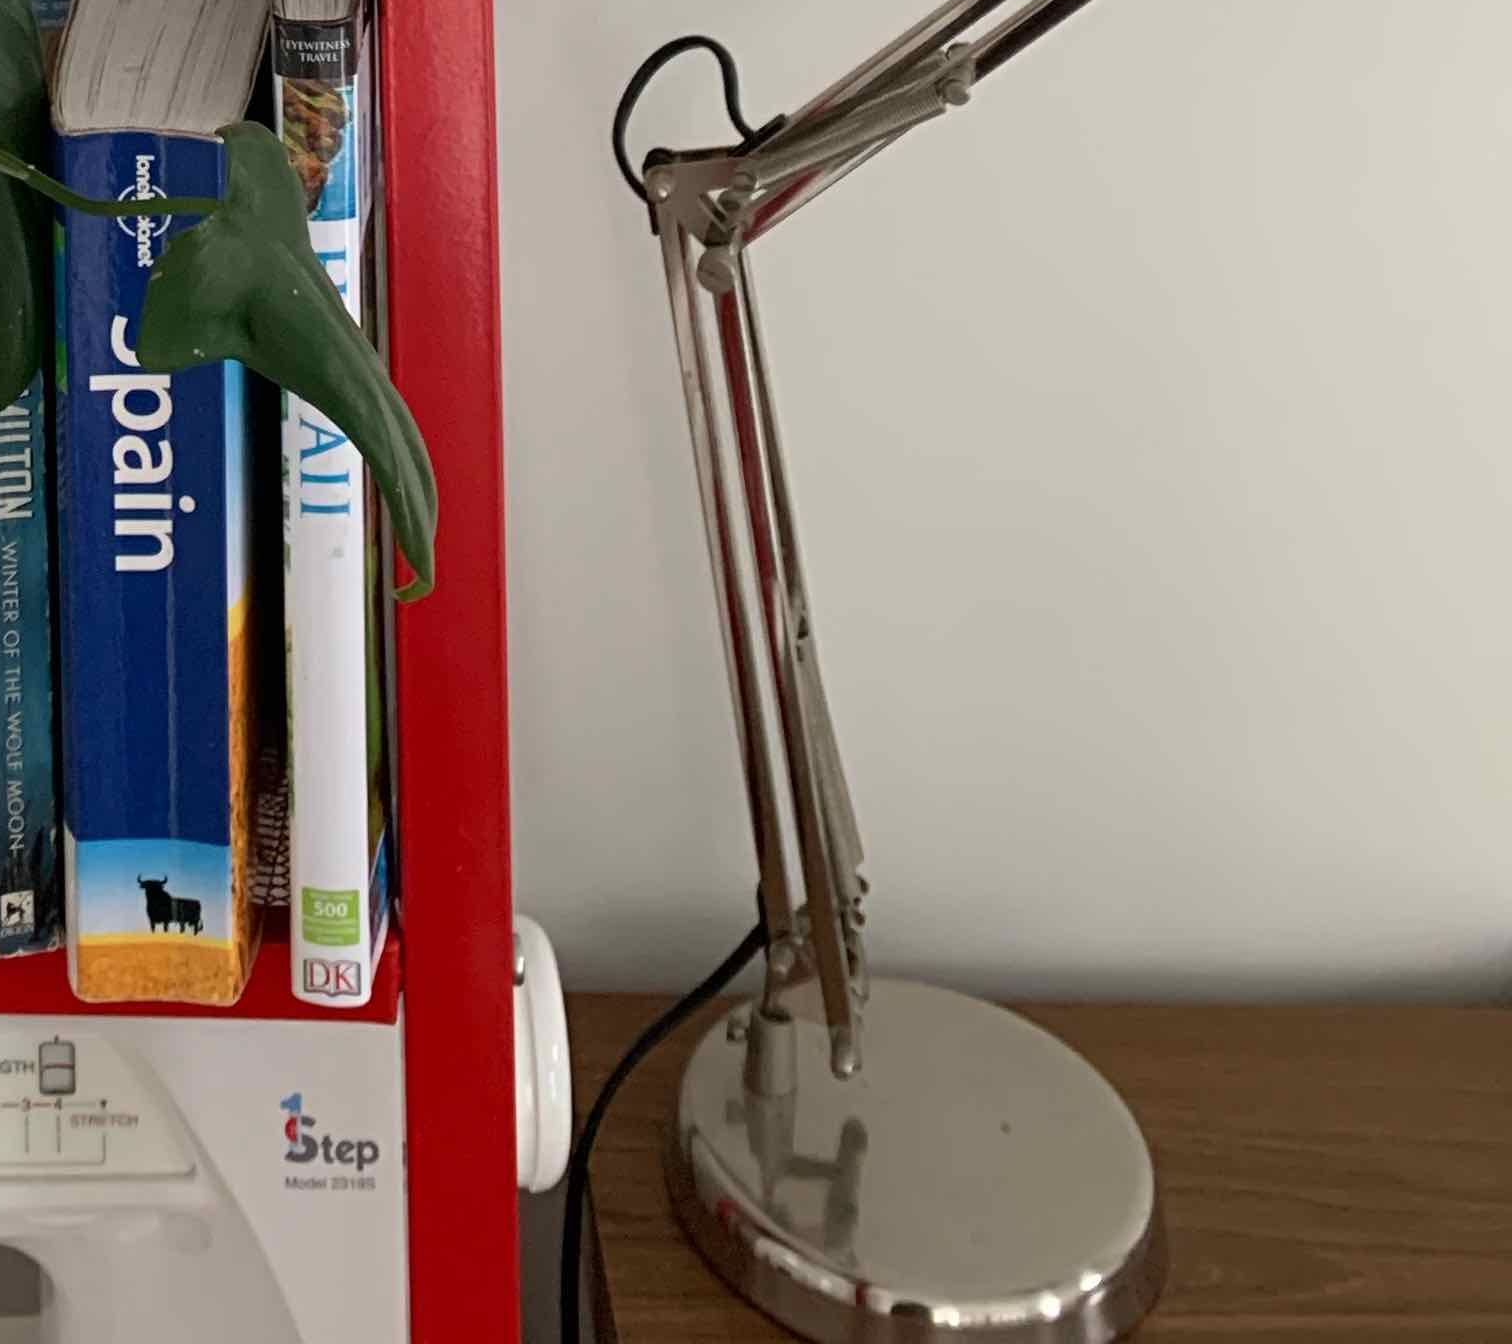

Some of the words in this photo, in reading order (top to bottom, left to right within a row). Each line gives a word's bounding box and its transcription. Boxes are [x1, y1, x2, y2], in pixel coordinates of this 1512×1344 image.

[286, 39, 351, 52] EYEWITNESS
[300, 52, 340, 64] TRAVEL
[131, 154, 156, 201] lonel
[1, 540, 20, 623] WINTER
[3, 630, 21, 658] OF
[4, 666, 22, 704] THE
[6, 711, 24, 771] WOLF
[7, 779, 25, 852] MOON
[313, 901, 349, 918] 500
[308, 959, 357, 993] DK
[284, 1114, 380, 1172] Step
